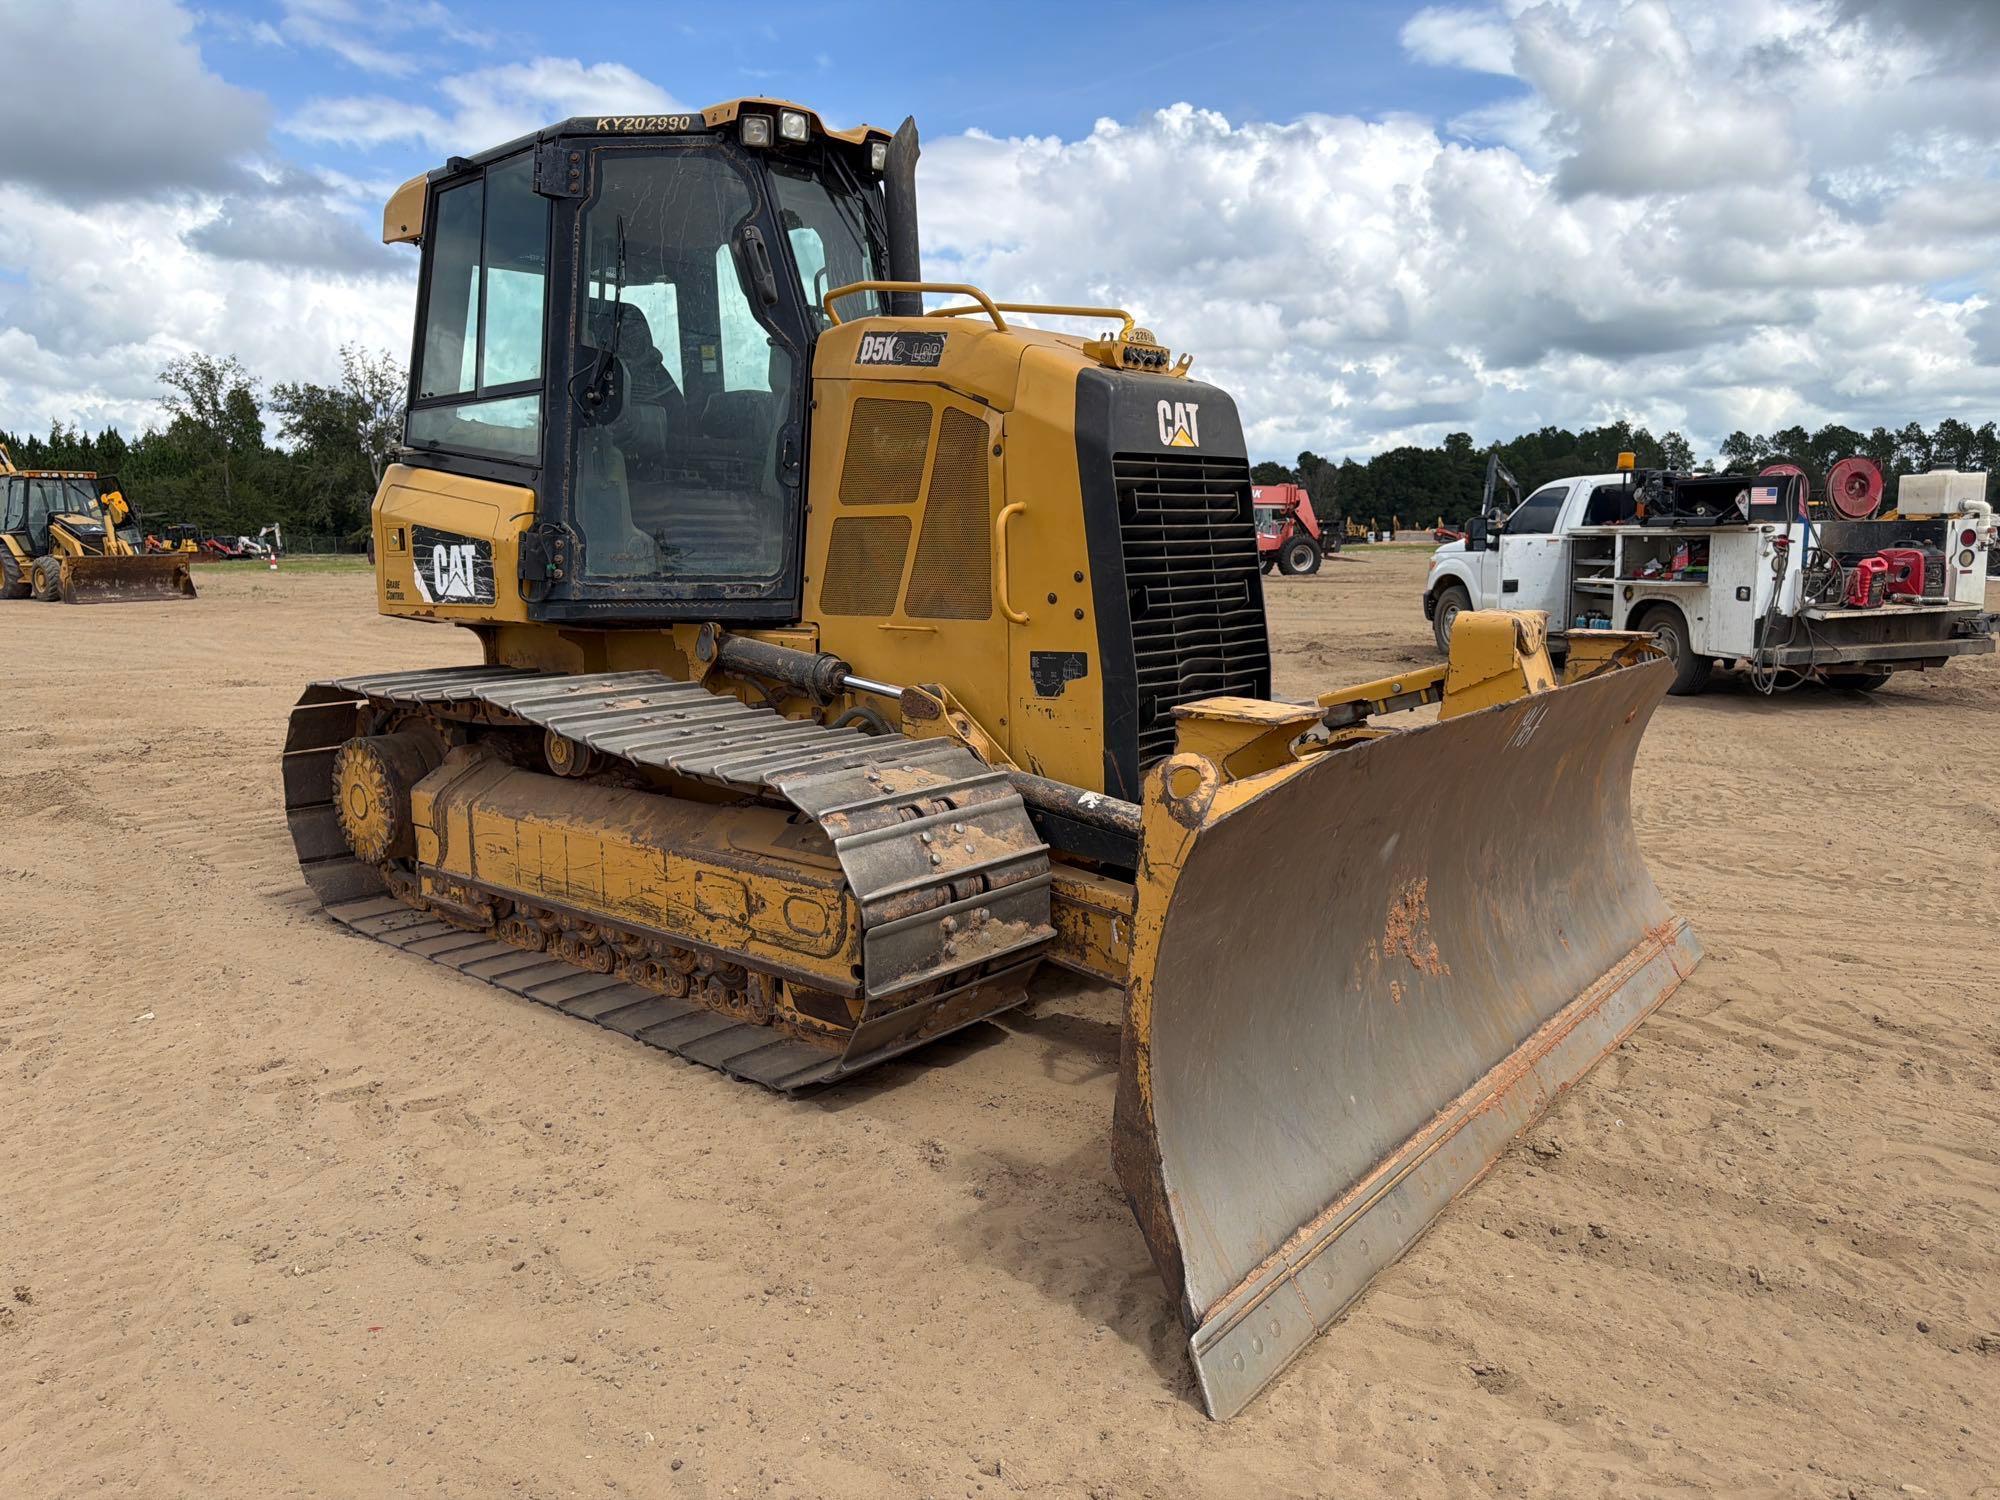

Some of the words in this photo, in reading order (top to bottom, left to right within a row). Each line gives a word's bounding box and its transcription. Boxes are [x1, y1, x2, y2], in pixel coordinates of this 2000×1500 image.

[596, 116, 690, 131] KY202990
[1157, 399, 1200, 448] CAT
[433, 544, 476, 598] CAT
